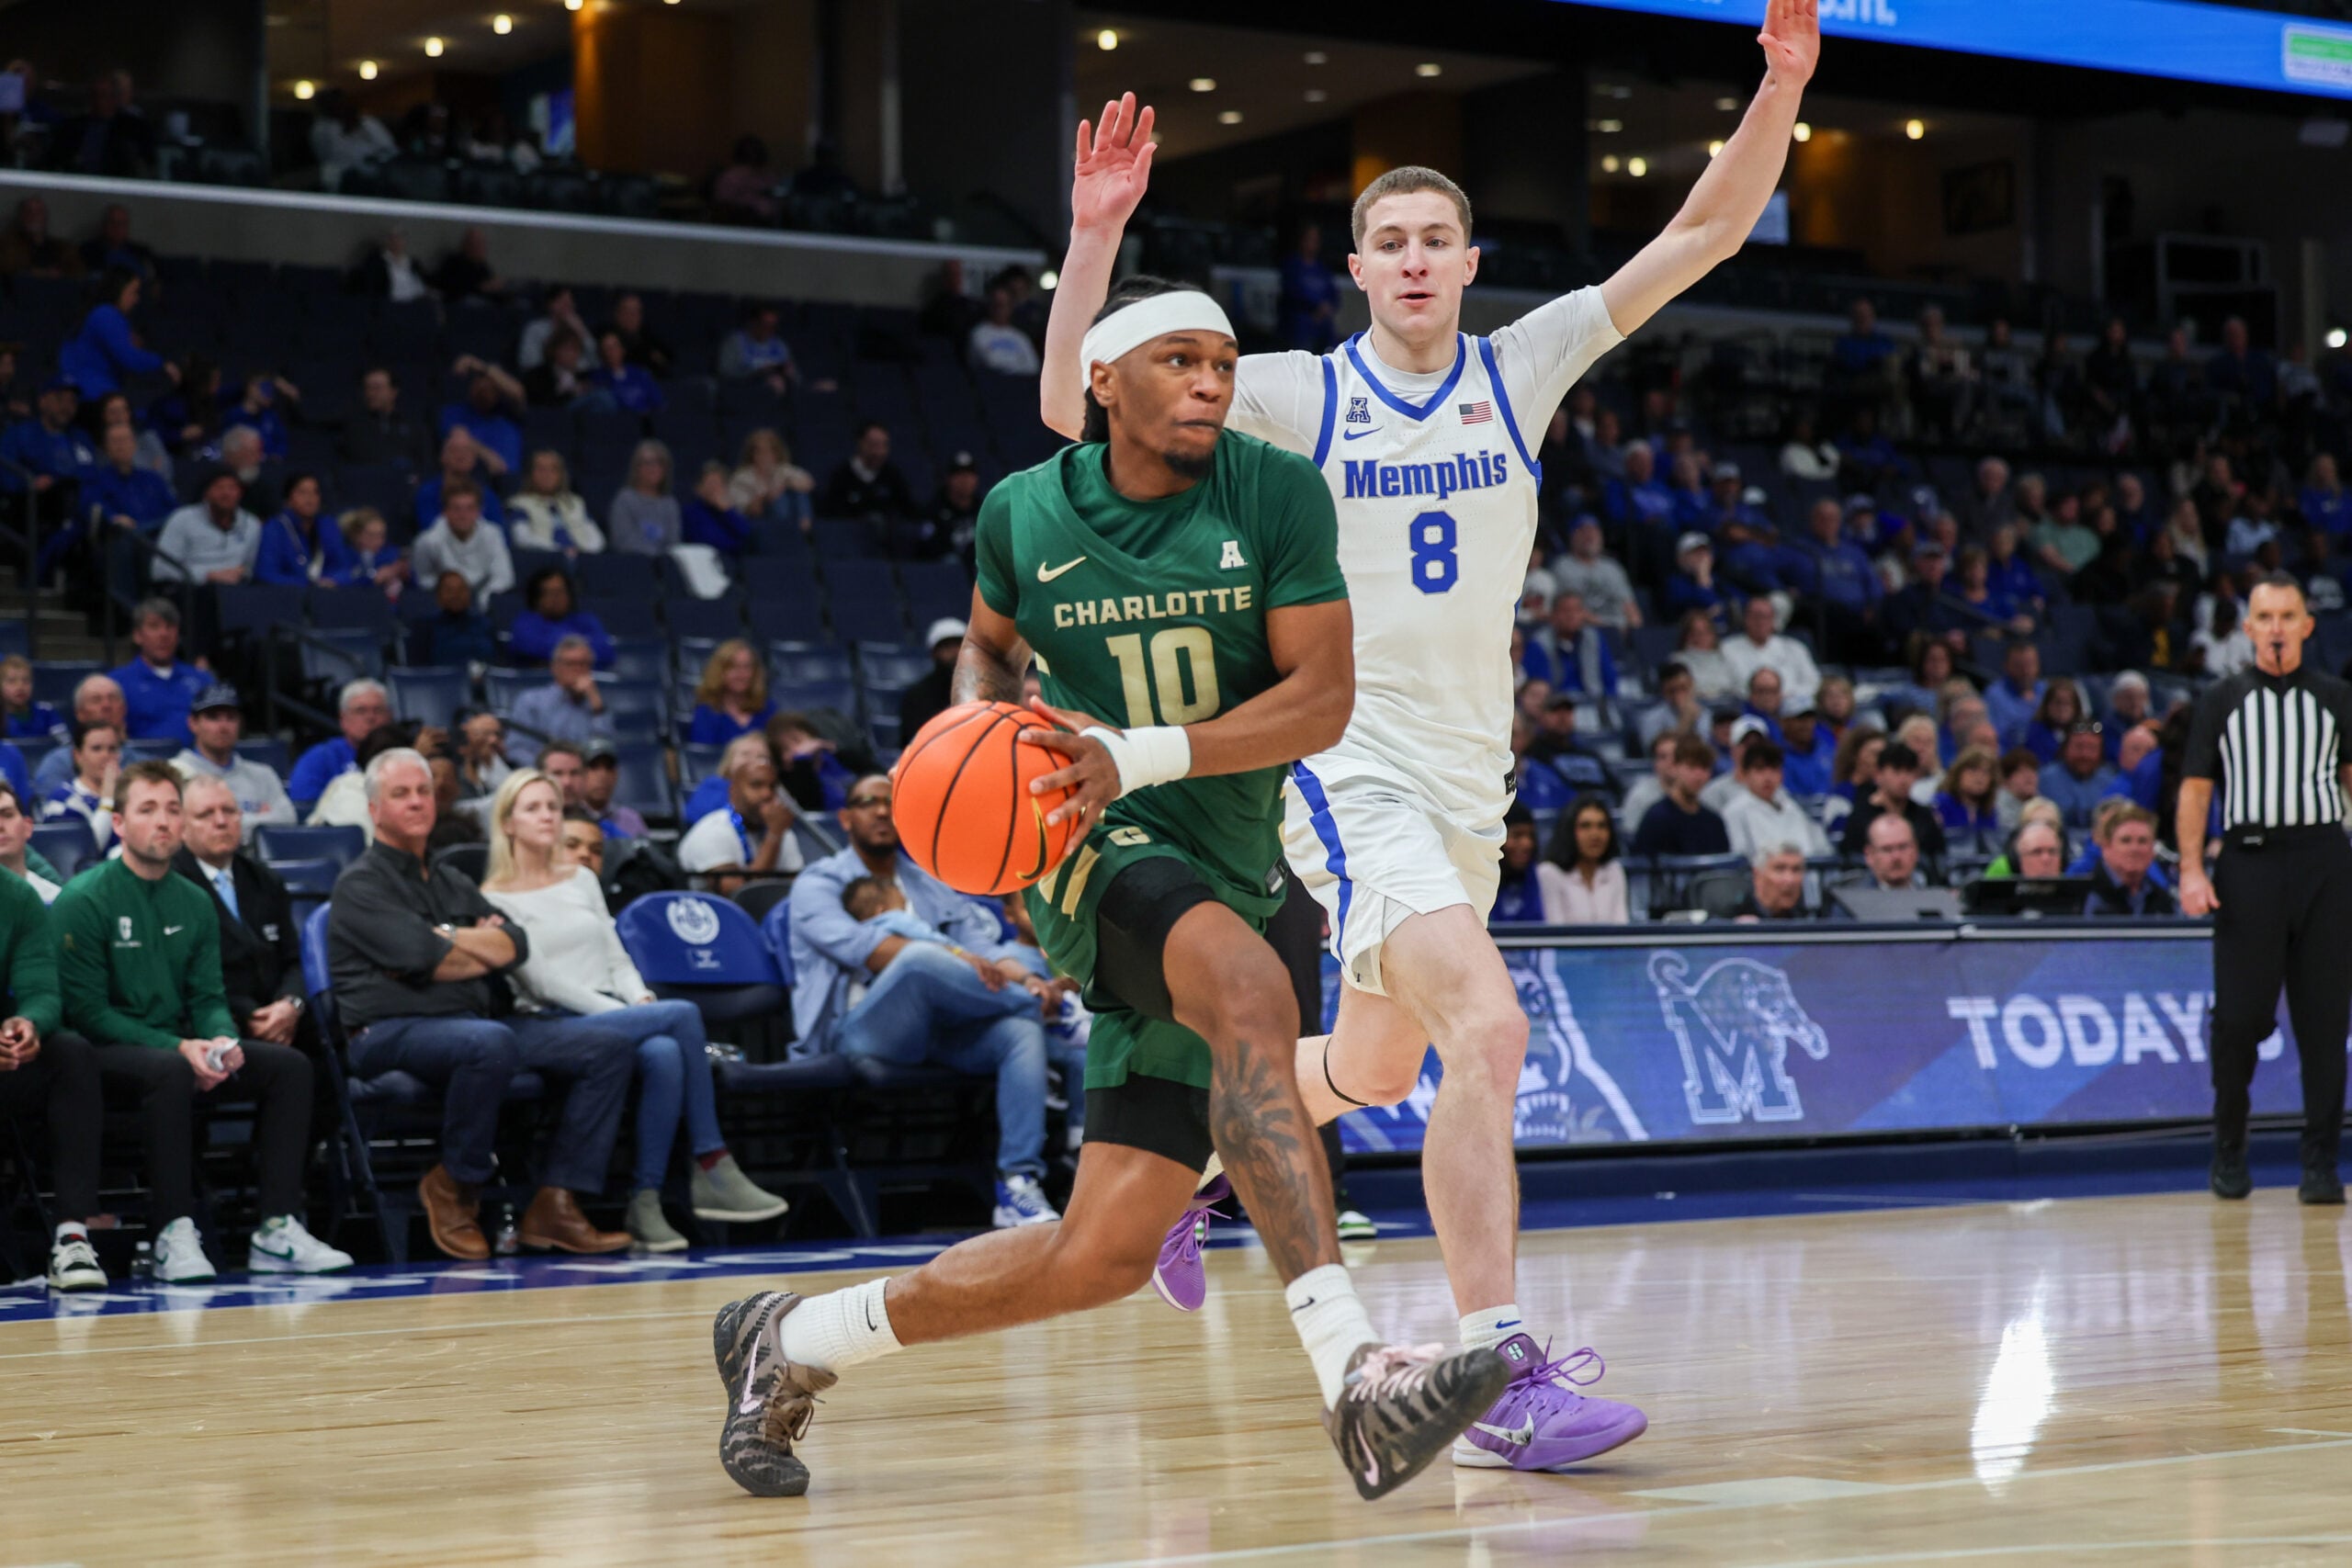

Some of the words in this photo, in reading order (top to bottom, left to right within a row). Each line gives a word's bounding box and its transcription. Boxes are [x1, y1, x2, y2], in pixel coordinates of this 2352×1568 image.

[1341, 449, 1508, 501] Memphis
[1409, 510, 1459, 595] 8
[1053, 585, 1252, 632] CHARLOTTE
[1105, 626, 1221, 728] 10
